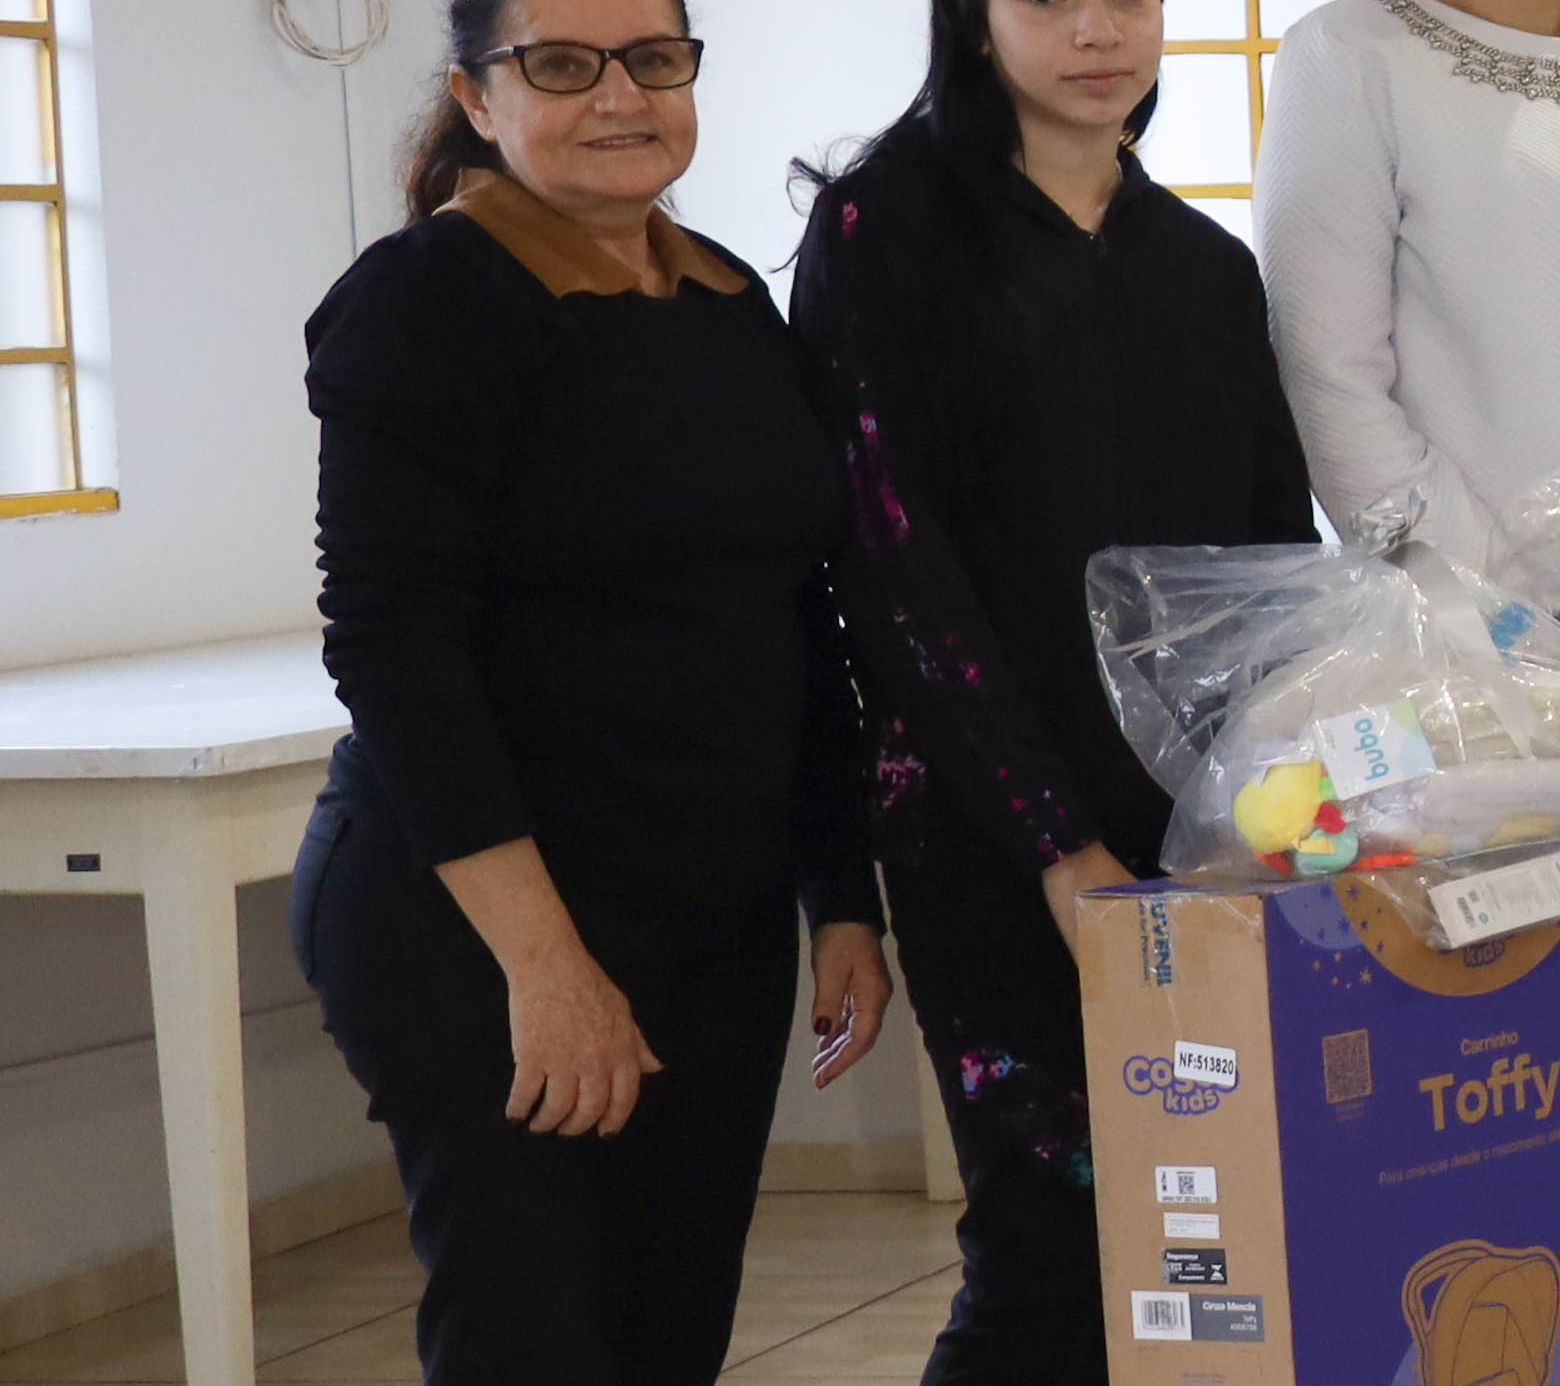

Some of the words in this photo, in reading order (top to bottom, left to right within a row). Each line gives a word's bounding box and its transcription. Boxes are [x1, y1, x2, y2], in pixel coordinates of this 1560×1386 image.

[1461, 1031, 1519, 1055] Carrinho
[1179, 1052, 1234, 1075] NF:513820
[1419, 1053, 1560, 1131] Toffy
